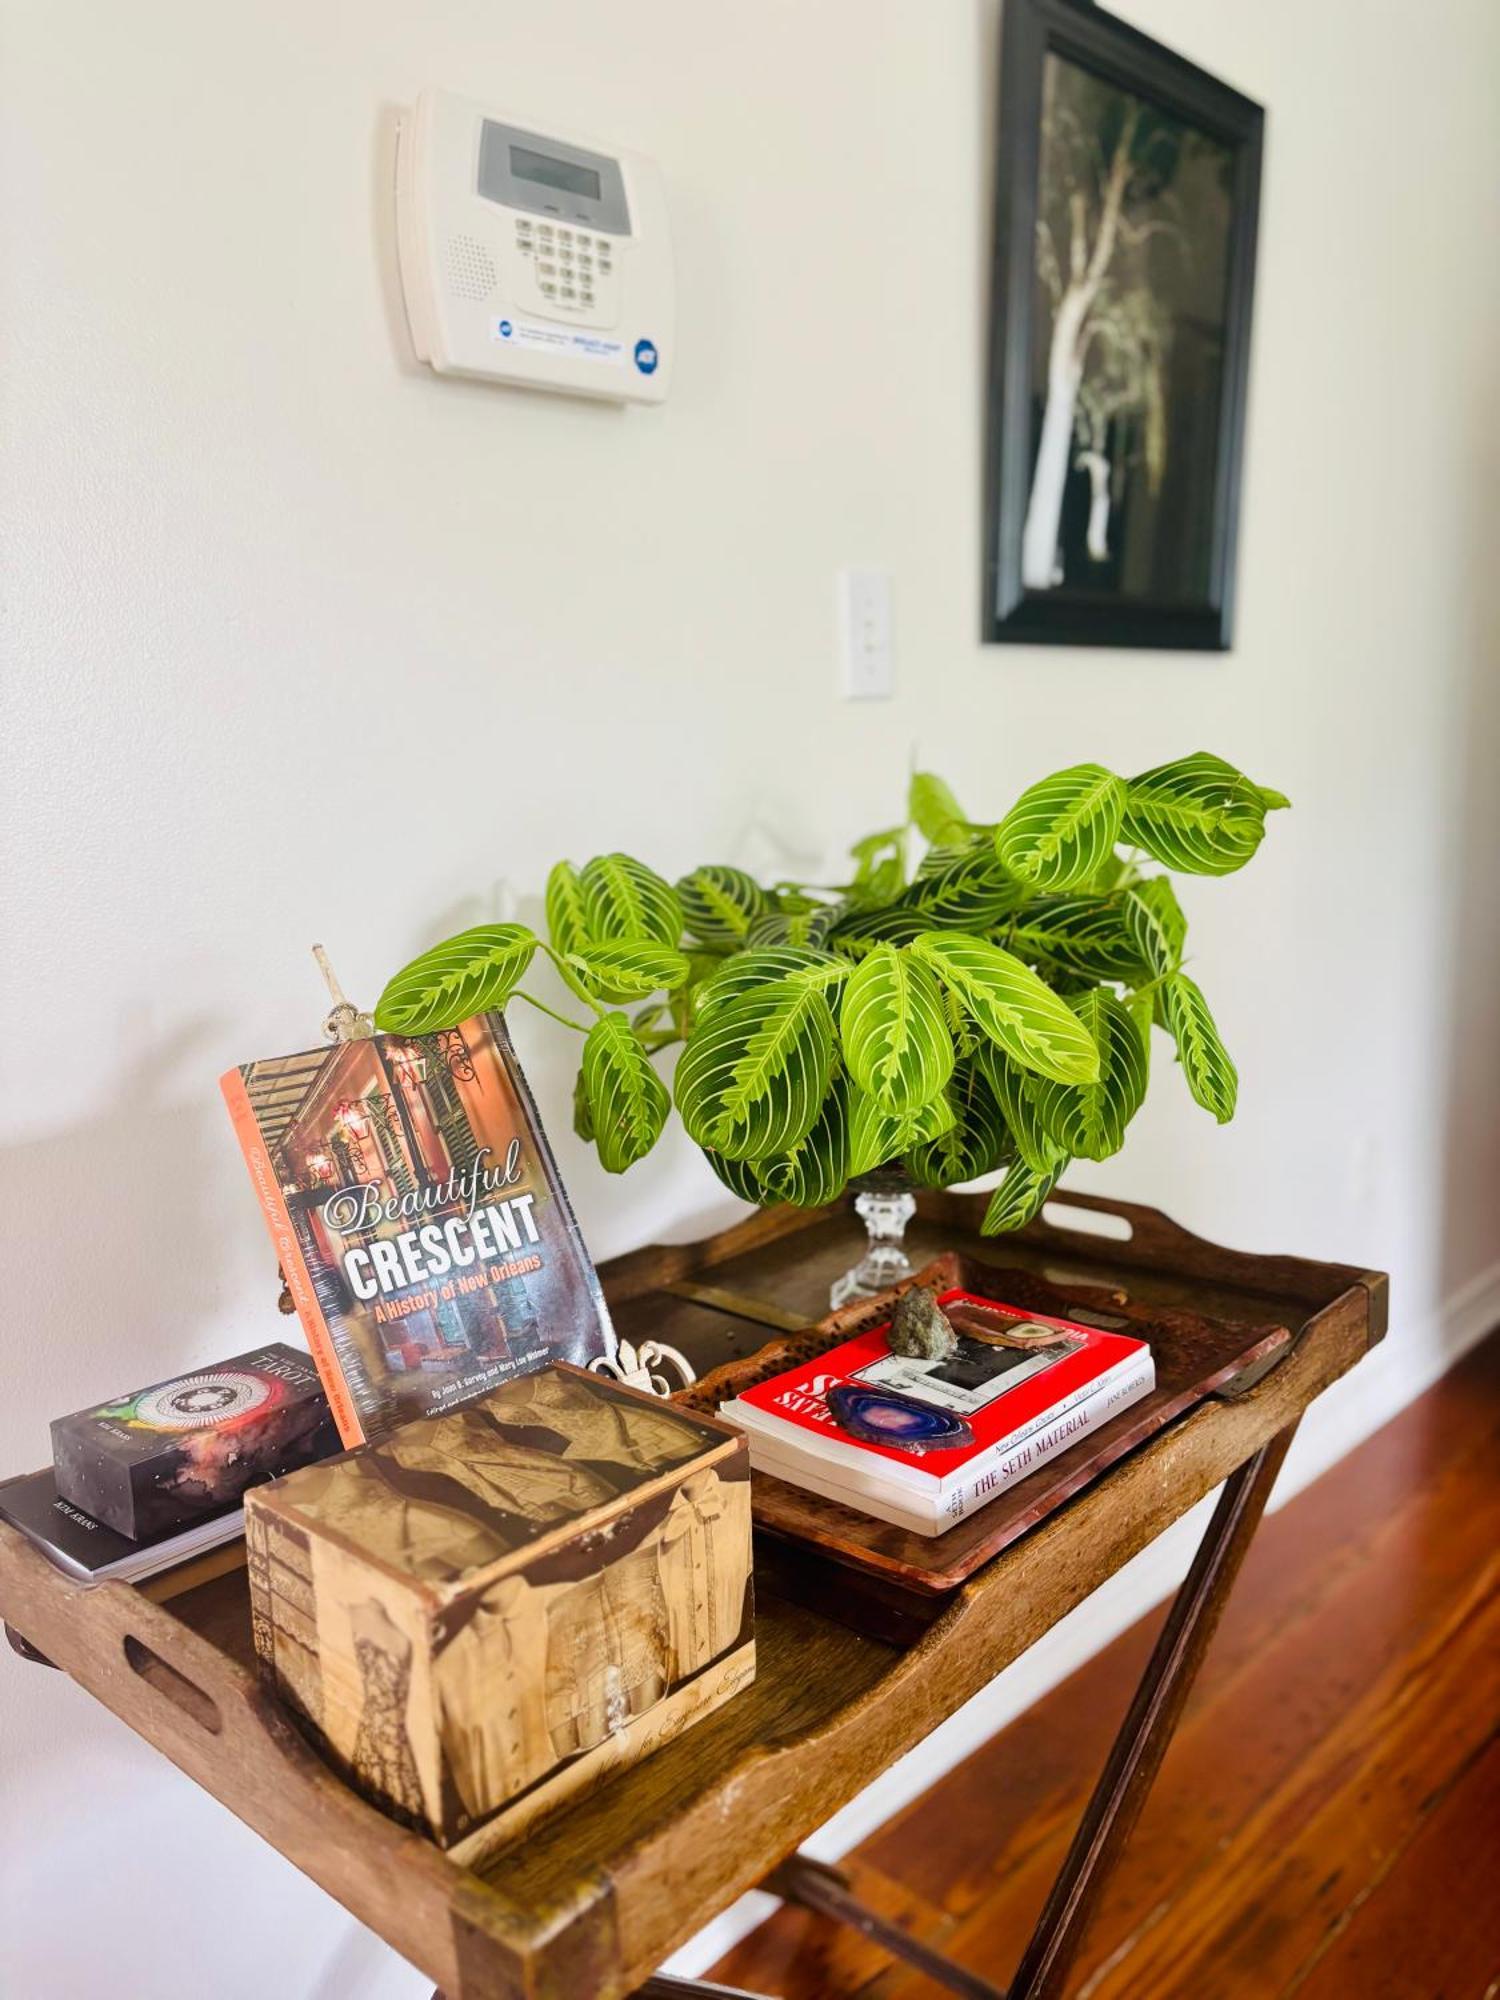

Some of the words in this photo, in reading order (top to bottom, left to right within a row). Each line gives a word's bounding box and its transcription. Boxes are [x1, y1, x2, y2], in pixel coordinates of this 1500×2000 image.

[323, 1139, 521, 1236] Beautiful
[250, 1147, 285, 1230] Beautiful
[279, 1234, 310, 1305] Crescent
[332, 1392, 351, 1433] Orleans
[343, 1194, 540, 1300] CRESCENT
[374, 1304, 387, 1324] A
[386, 1290, 439, 1319] History
[440, 1280, 457, 1301] of
[457, 1271, 490, 1296] New
[490, 1254, 542, 1283] Orleans
[250, 1355, 317, 1387] TAROT
[487, 1366, 500, 1378] and
[499, 1360, 516, 1373] Mary
[973, 1472, 998, 1498] THE
[1001, 1448, 1033, 1481] SETH
[1035, 1409, 1091, 1456] MATERIAL
